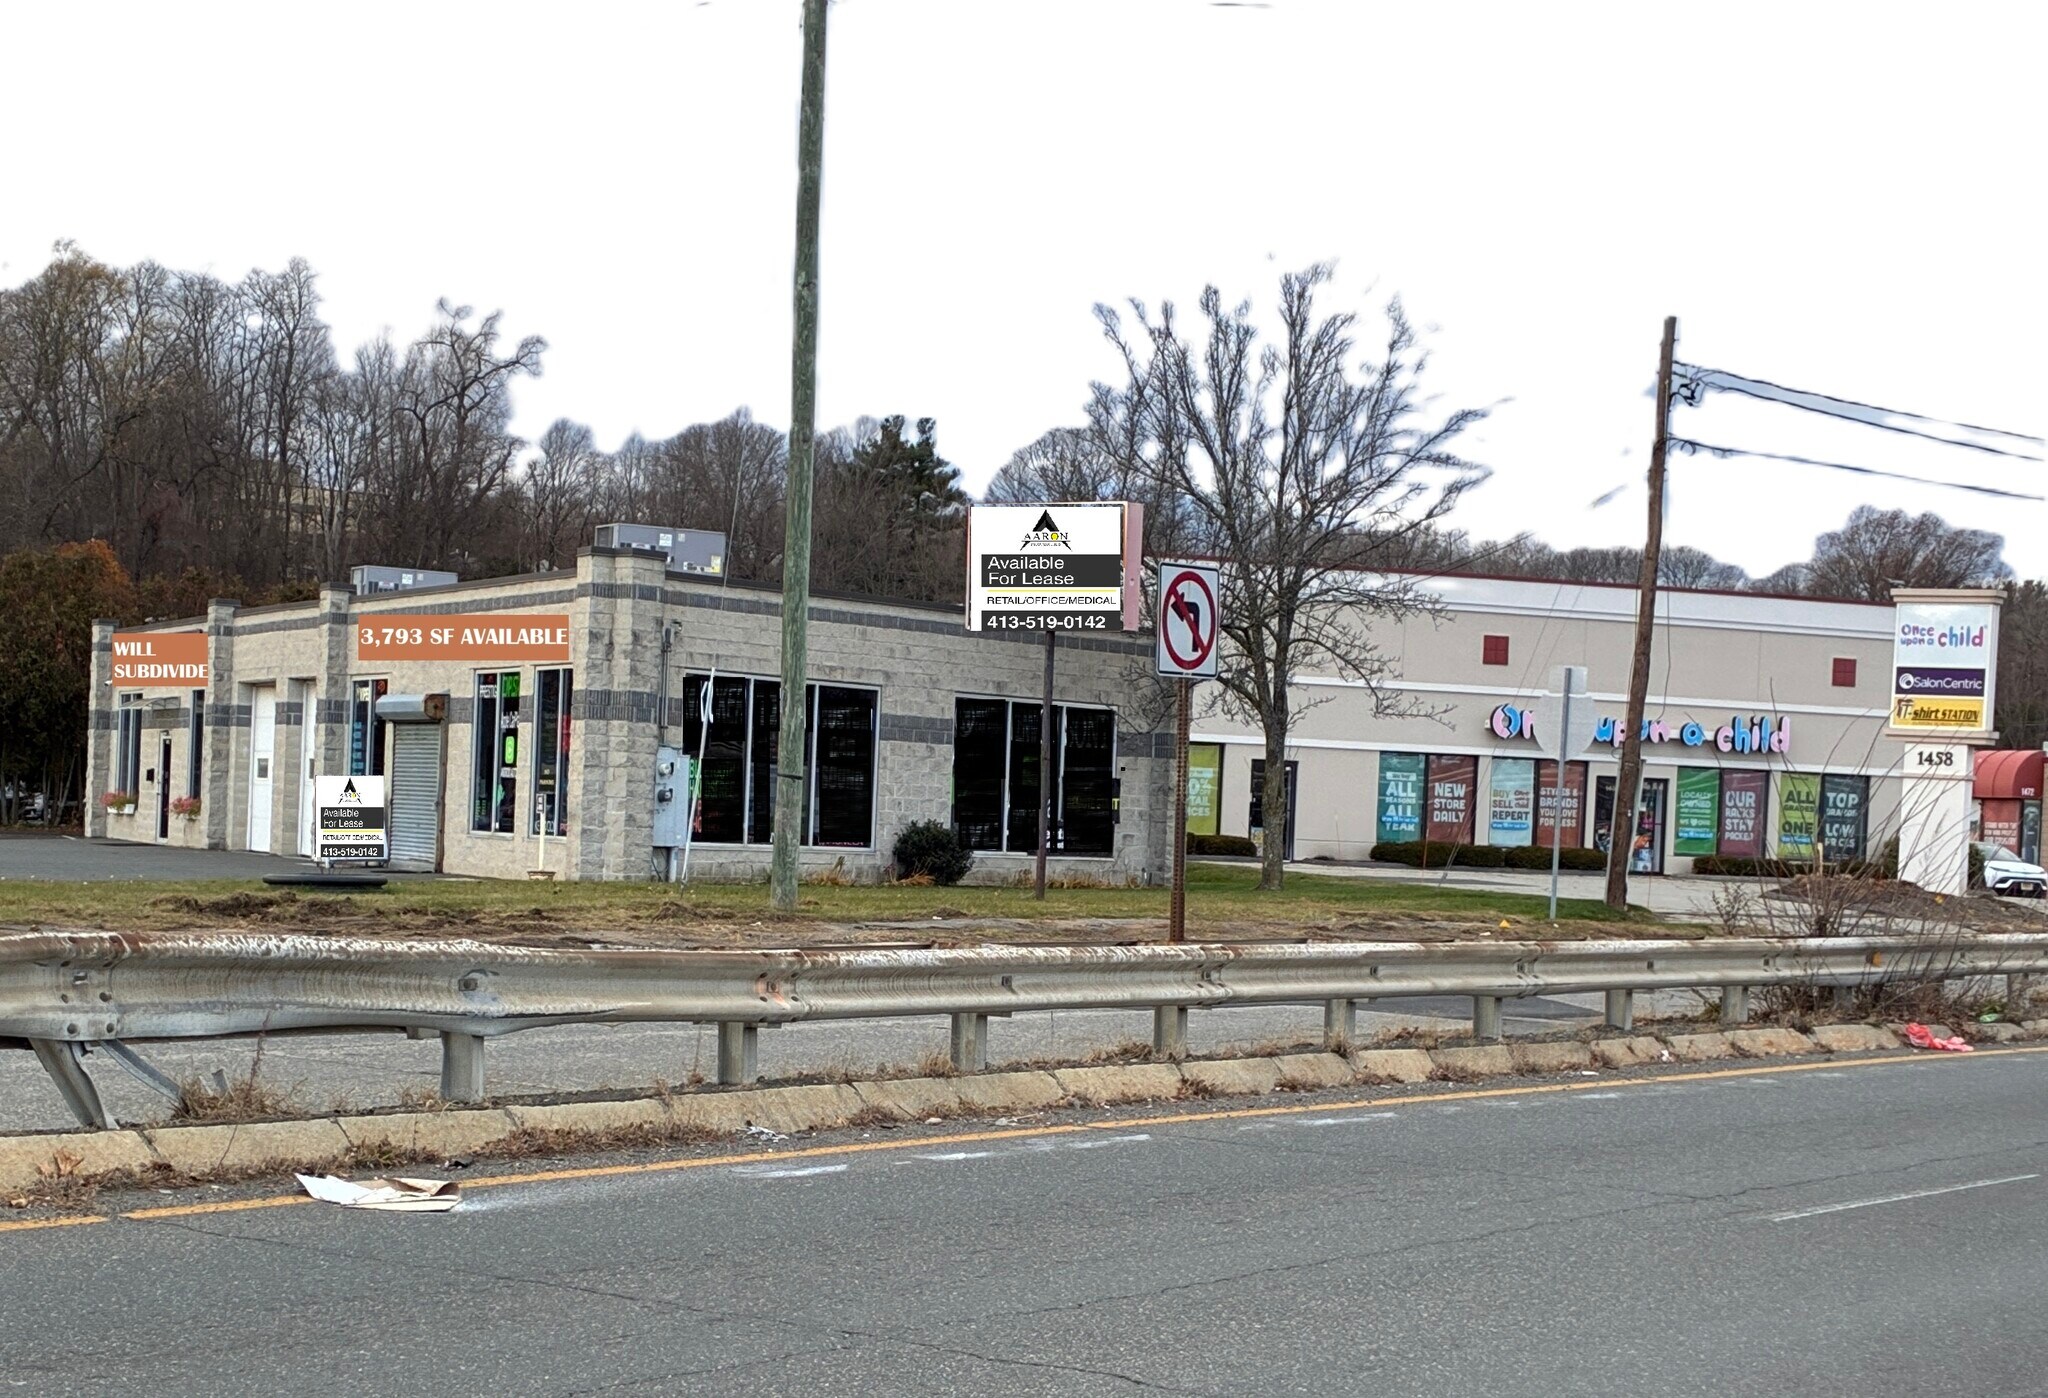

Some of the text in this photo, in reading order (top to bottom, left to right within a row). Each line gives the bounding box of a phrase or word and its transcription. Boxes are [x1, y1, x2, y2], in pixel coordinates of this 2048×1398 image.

[1023, 532, 1069, 541] AARON
[987, 556, 1065, 570] Available
[988, 572, 1075, 585] For Lease
[986, 596, 1117, 605] RETAIL/OFFICE/MEDICAL
[986, 615, 1106, 629] 413-519-0142
[1901, 623, 1935, 637] Once
[1937, 625, 1985, 648] child
[1900, 636, 1935, 647] upon a
[1913, 675, 1983, 690] SalonCentric
[1897, 699, 1980, 721] T-shirt STATION
[1490, 703, 1535, 740] On
[1680, 721, 1705, 747] a
[1715, 714, 1791, 755] child
[1917, 750, 1954, 767] 1458
[1386, 781, 1417, 797] ALL
[1434, 782, 1467, 798] NEW
[1540, 787, 1571, 797] STYES
[1188, 796, 1211, 806] TAIL
[1725, 790, 1756, 807] OUR
[1785, 790, 1816, 804] ALL
[1826, 792, 1859, 808] TOP
[1433, 798, 1467, 810] STORE
[1491, 799, 1514, 809] SELL
[323, 808, 360, 818] Available
[1188, 806, 1211, 817] ICES
[1433, 810, 1465, 823] DAILY
[1491, 810, 1530, 821] REPEAT
[1540, 808, 1578, 818] YOU OVE
[323, 819, 364, 828] For Lease
[1539, 817, 1555, 827] FOR
[1560, 818, 1577, 828] ESS
[1781, 820, 1814, 835] ONE
[322, 847, 378, 856] 413-519-0142
